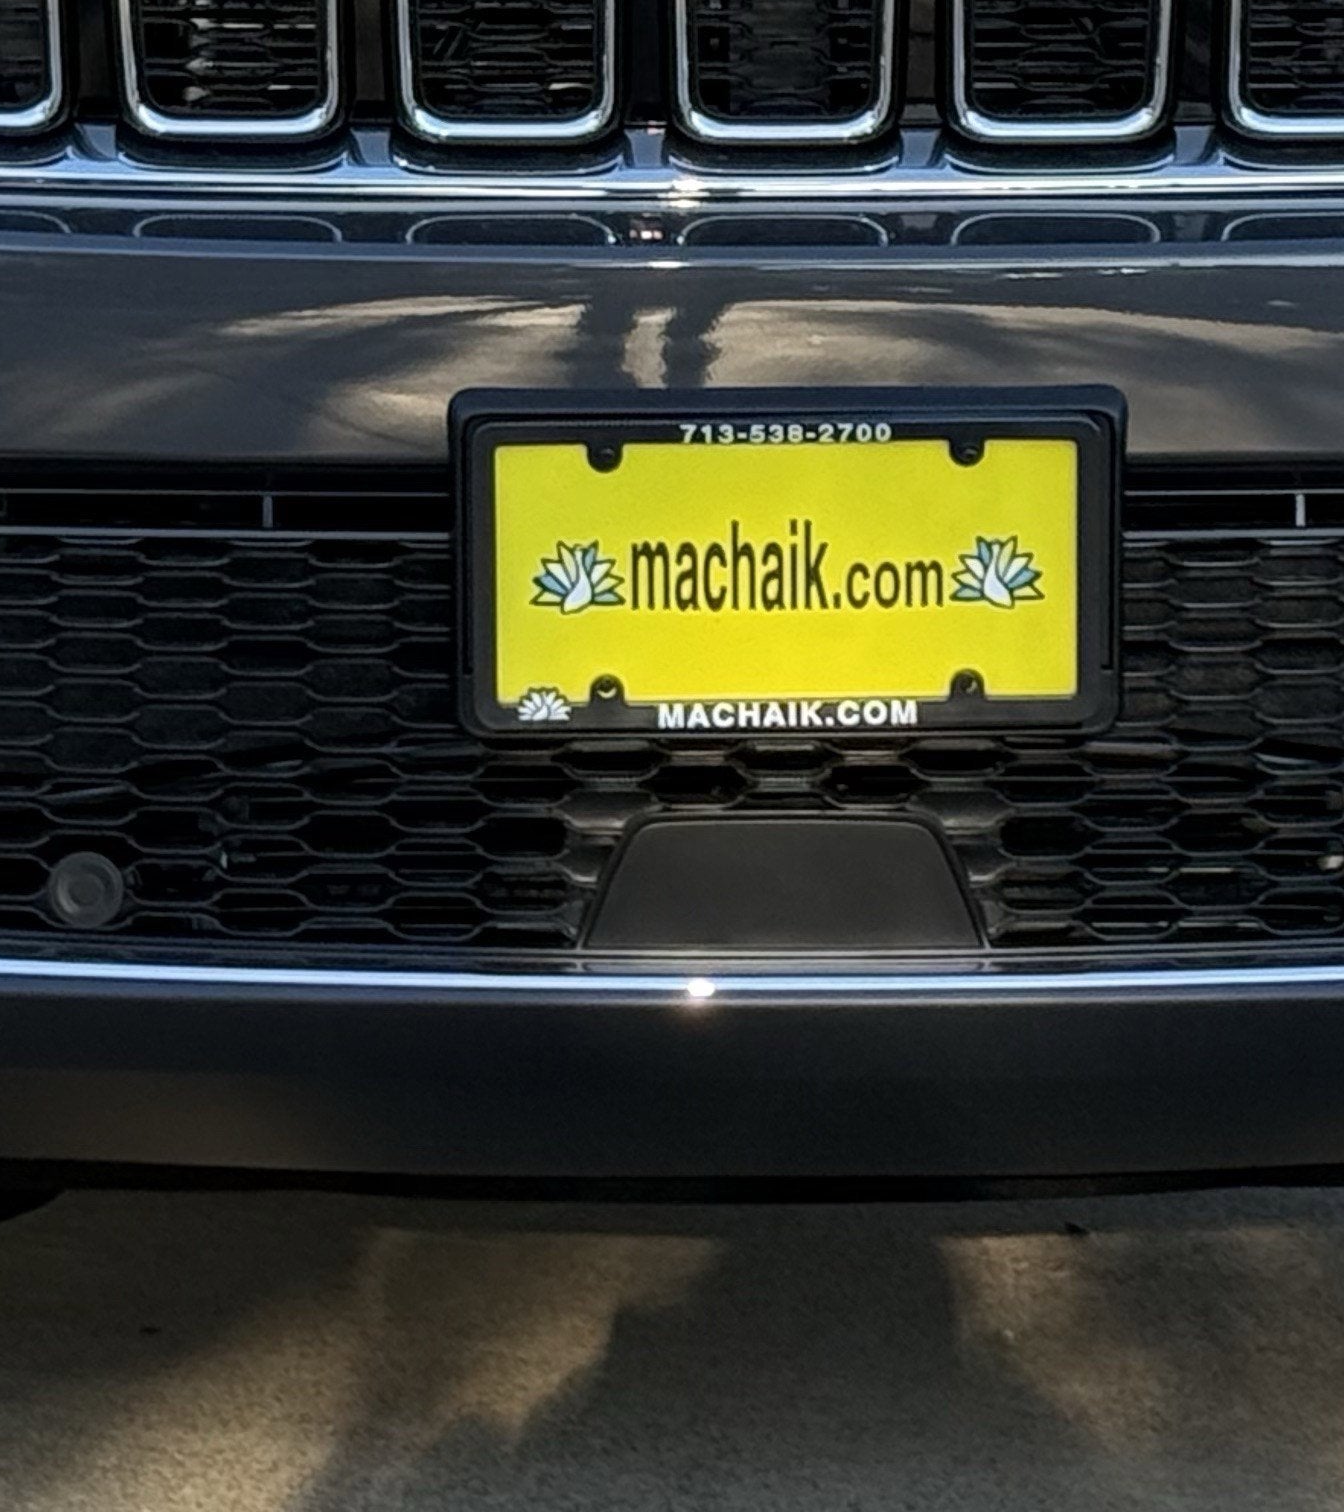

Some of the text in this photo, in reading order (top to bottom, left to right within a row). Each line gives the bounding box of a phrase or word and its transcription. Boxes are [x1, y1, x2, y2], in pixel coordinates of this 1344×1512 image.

[679, 423, 892, 444] 713-538-2700
[630, 518, 944, 612] machaik.com
[657, 700, 918, 729] MACHAIK.COM
